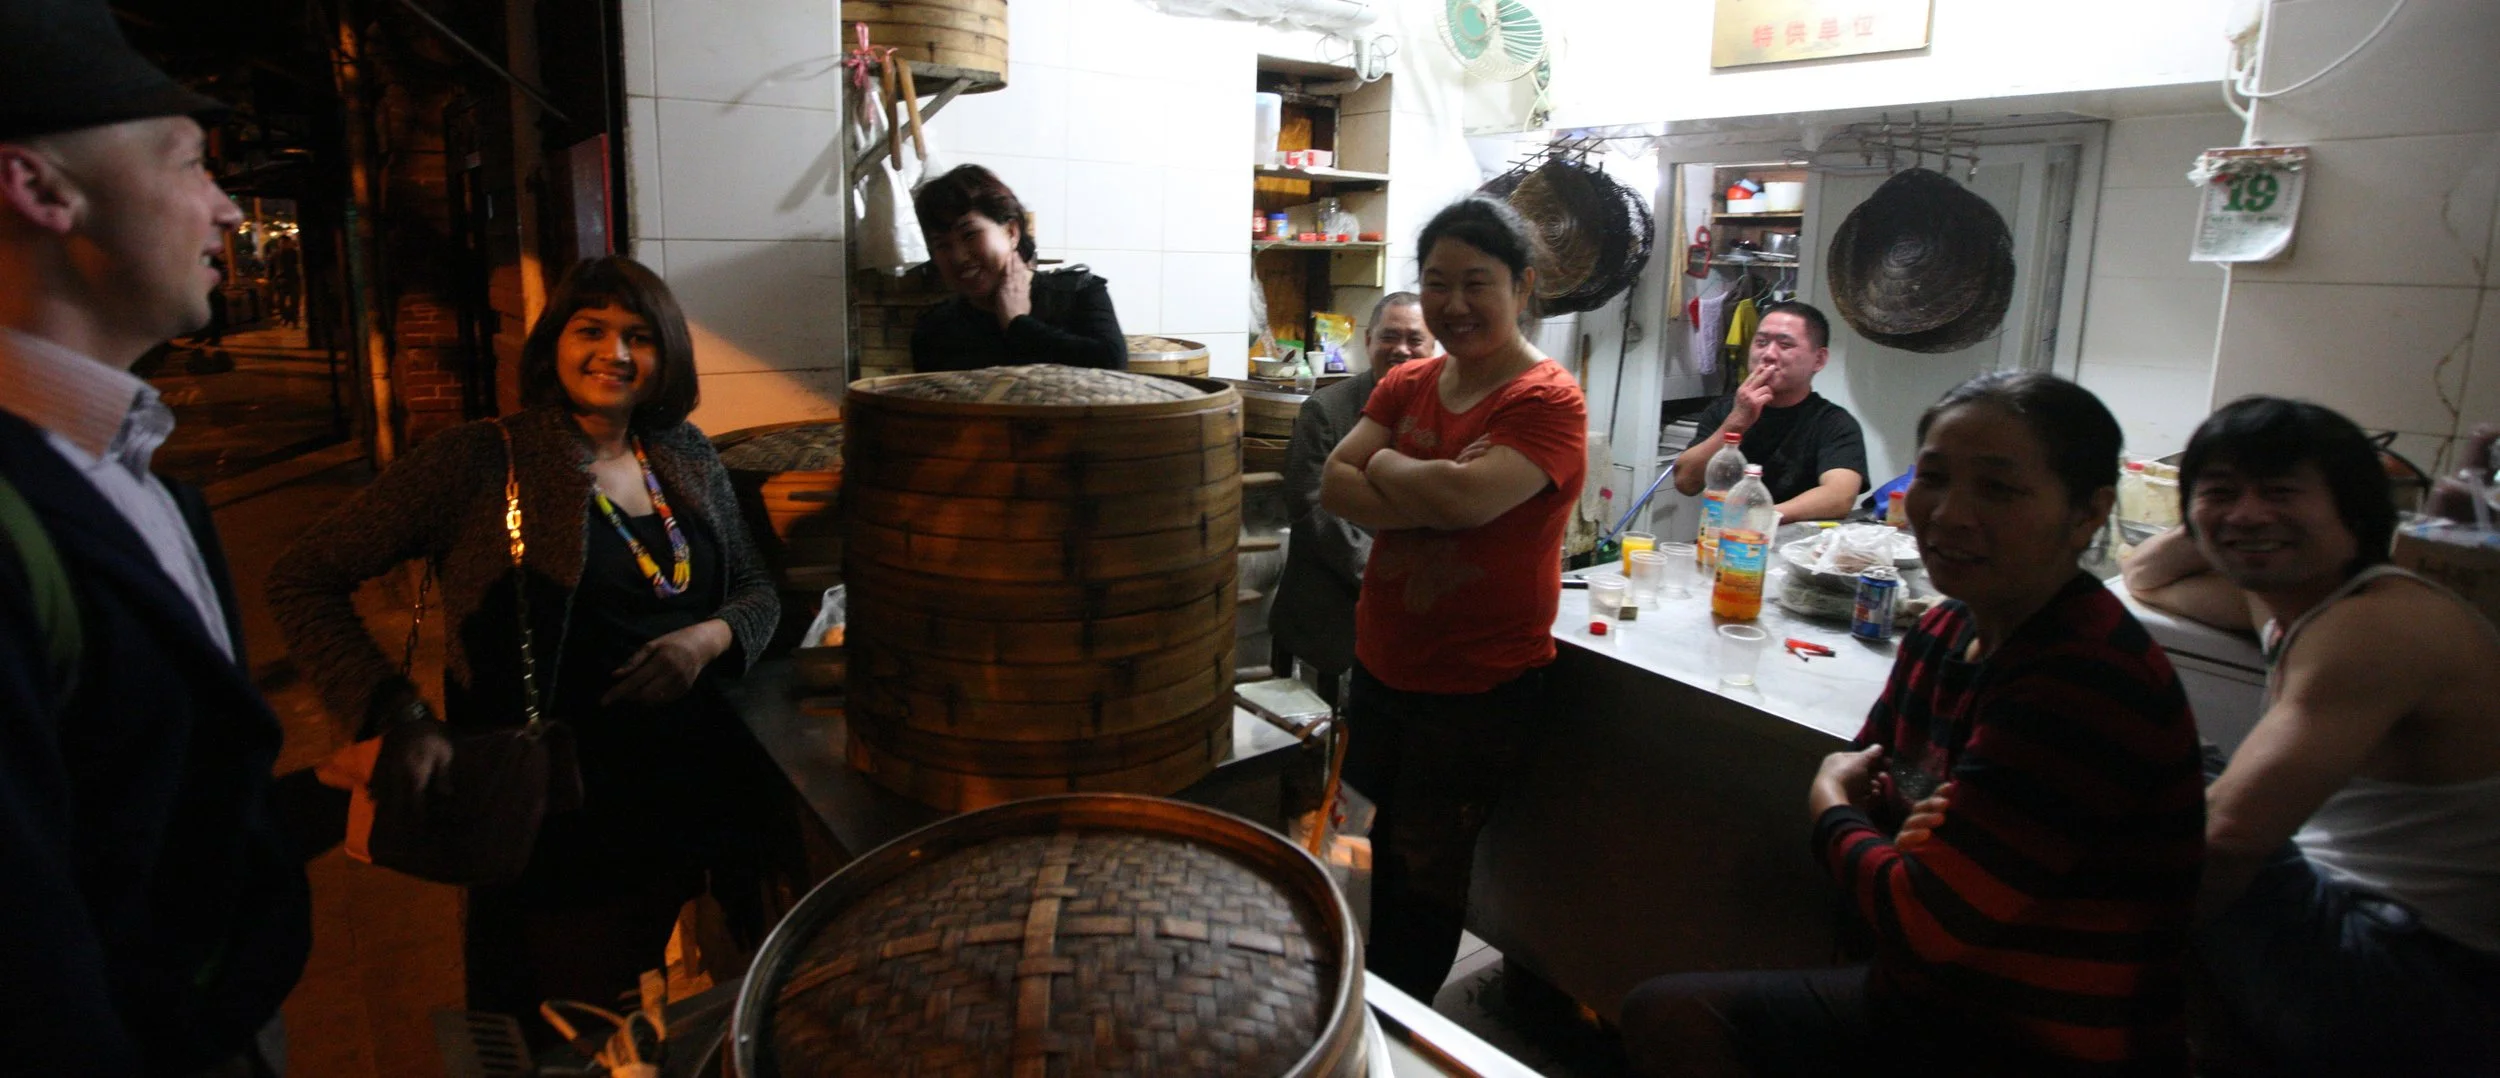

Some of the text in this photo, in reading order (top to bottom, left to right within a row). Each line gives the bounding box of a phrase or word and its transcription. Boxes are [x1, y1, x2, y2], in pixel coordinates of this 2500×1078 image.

[1752, 14, 1875, 48] 特供单位
[2222, 172, 2279, 212] 19
